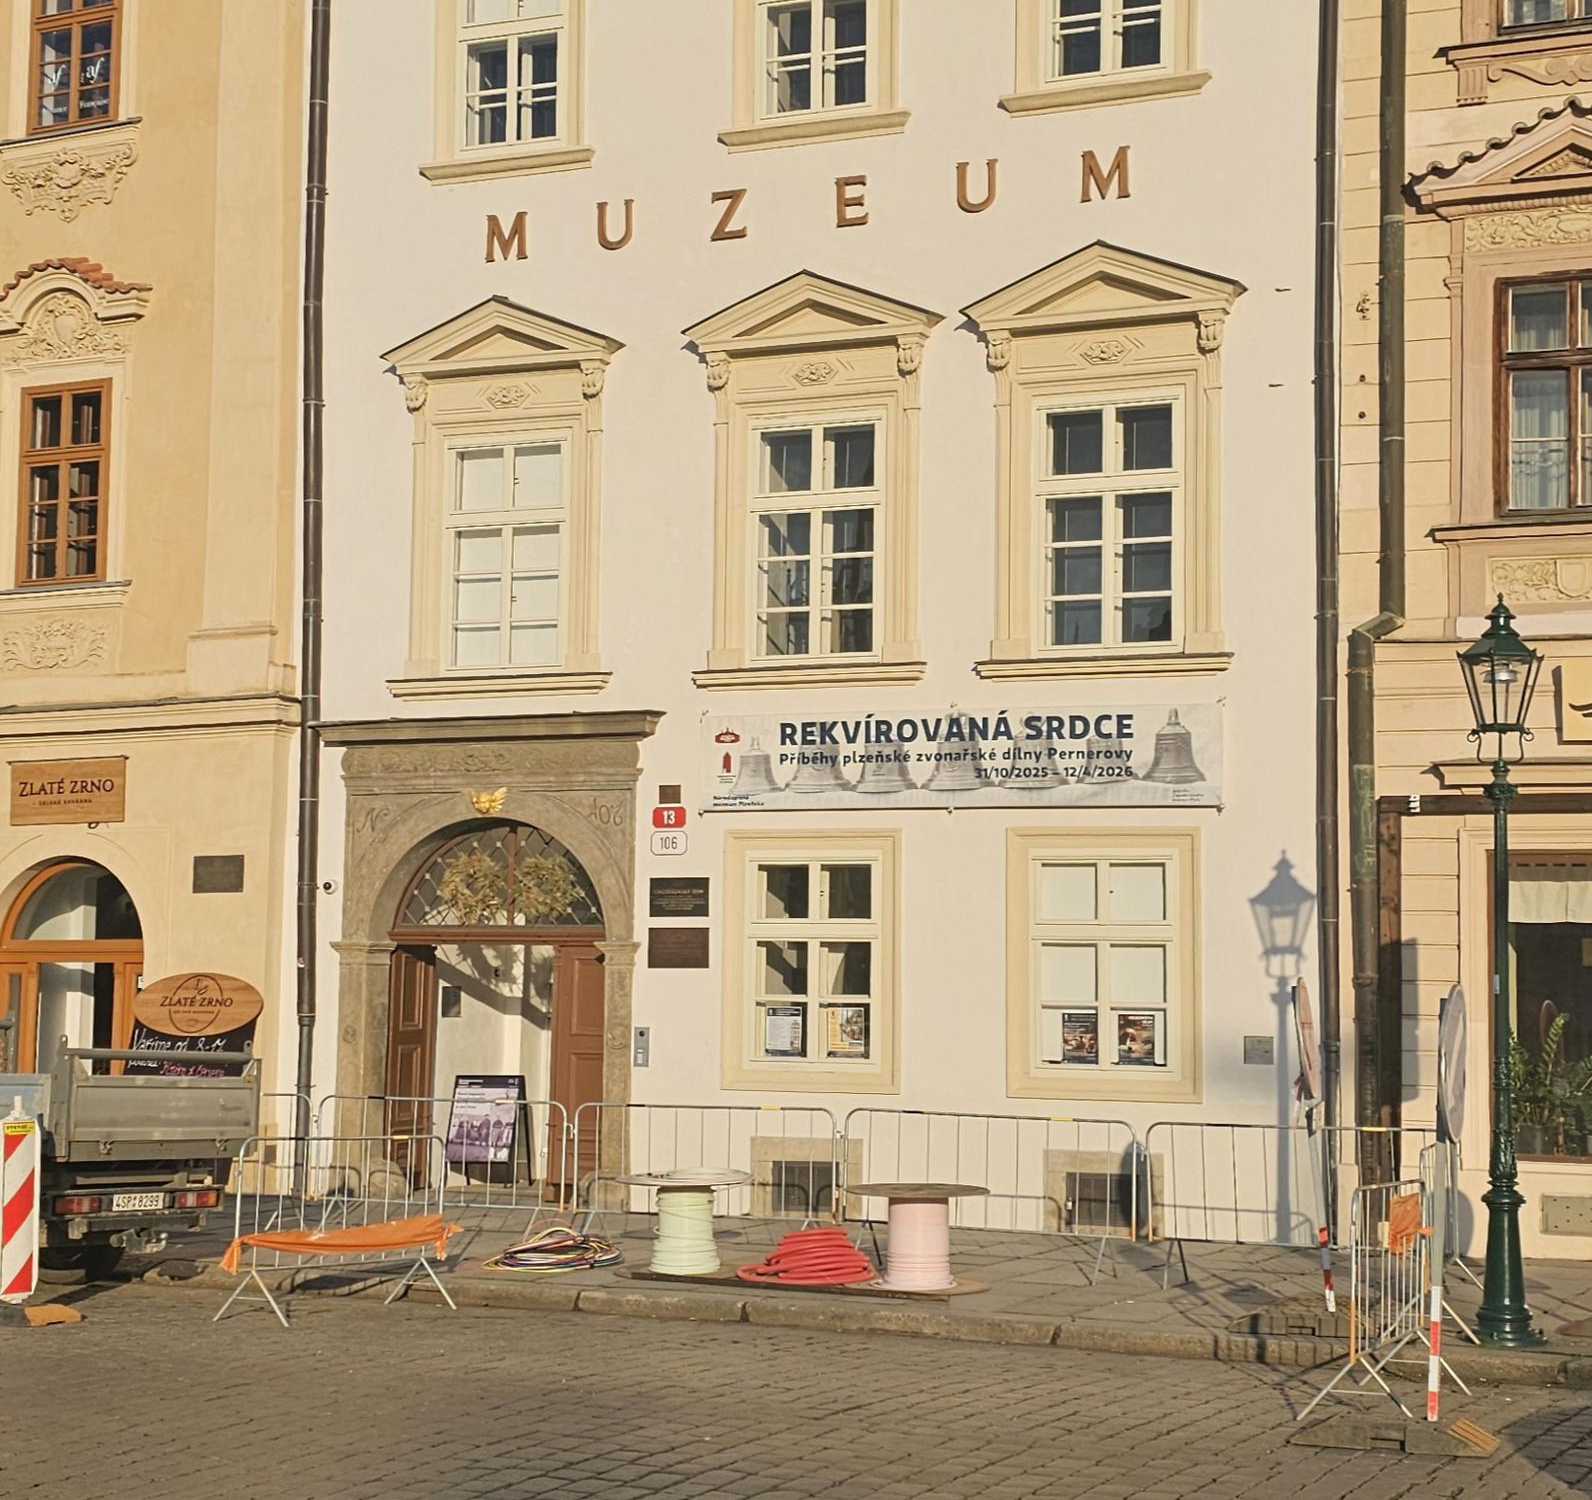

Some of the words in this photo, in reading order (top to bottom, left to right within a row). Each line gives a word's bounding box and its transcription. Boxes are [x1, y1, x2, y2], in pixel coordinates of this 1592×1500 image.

[485, 145, 1132, 263] MUZEUM
[780, 710, 1013, 746] REKVÍROVANÁ
[1024, 714, 1134, 741] SRDCE
[780, 751, 838, 767] Příběhy
[843, 750, 911, 767] plzeňské
[916, 747, 997, 763] zvonařské
[1002, 748, 1043, 763] dílny
[1047, 747, 1133, 762] Pernerovy
[975, 767, 1049, 779] 31/10/2025
[1065, 765, 1134, 779] 12/4/2026
[19, 778, 65, 797] ZLATÉ
[70, 779, 114, 793] ZRNO
[663, 810, 676, 825] 13
[660, 836, 678, 850] 106
[160, 995, 196, 1008] ZLATÉ
[199, 997, 234, 1008] ZRNO
